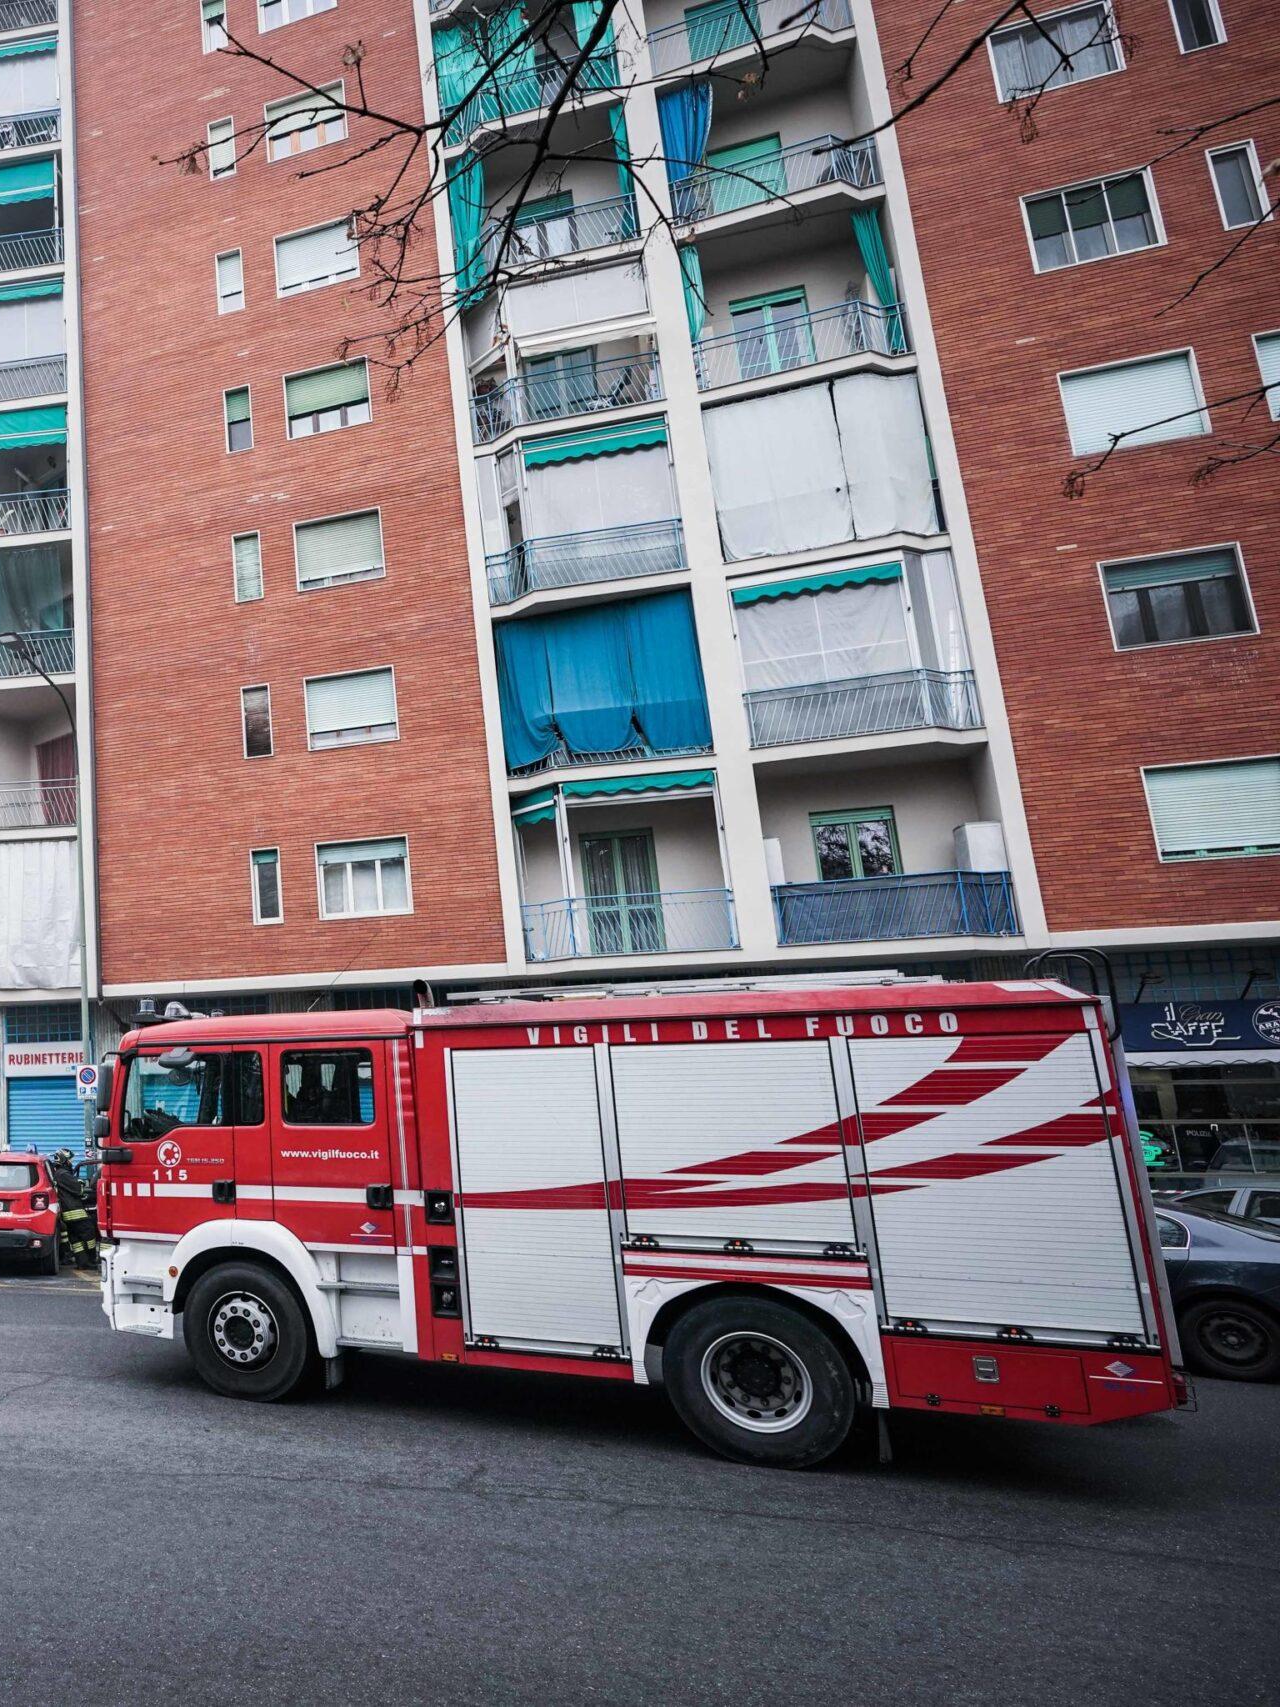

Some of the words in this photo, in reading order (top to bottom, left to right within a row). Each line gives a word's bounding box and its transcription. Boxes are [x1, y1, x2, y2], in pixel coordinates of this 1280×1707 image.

[1164, 1002, 1176, 1021] il
[527, 1022, 659, 1046] VIGILI
[691, 1018, 772, 1041] DEL
[805, 1012, 959, 1038] FUOCO
[8, 1051, 84, 1066] RUBINETTERIE
[280, 1149, 380, 1160] www.vigilfuoco.it
